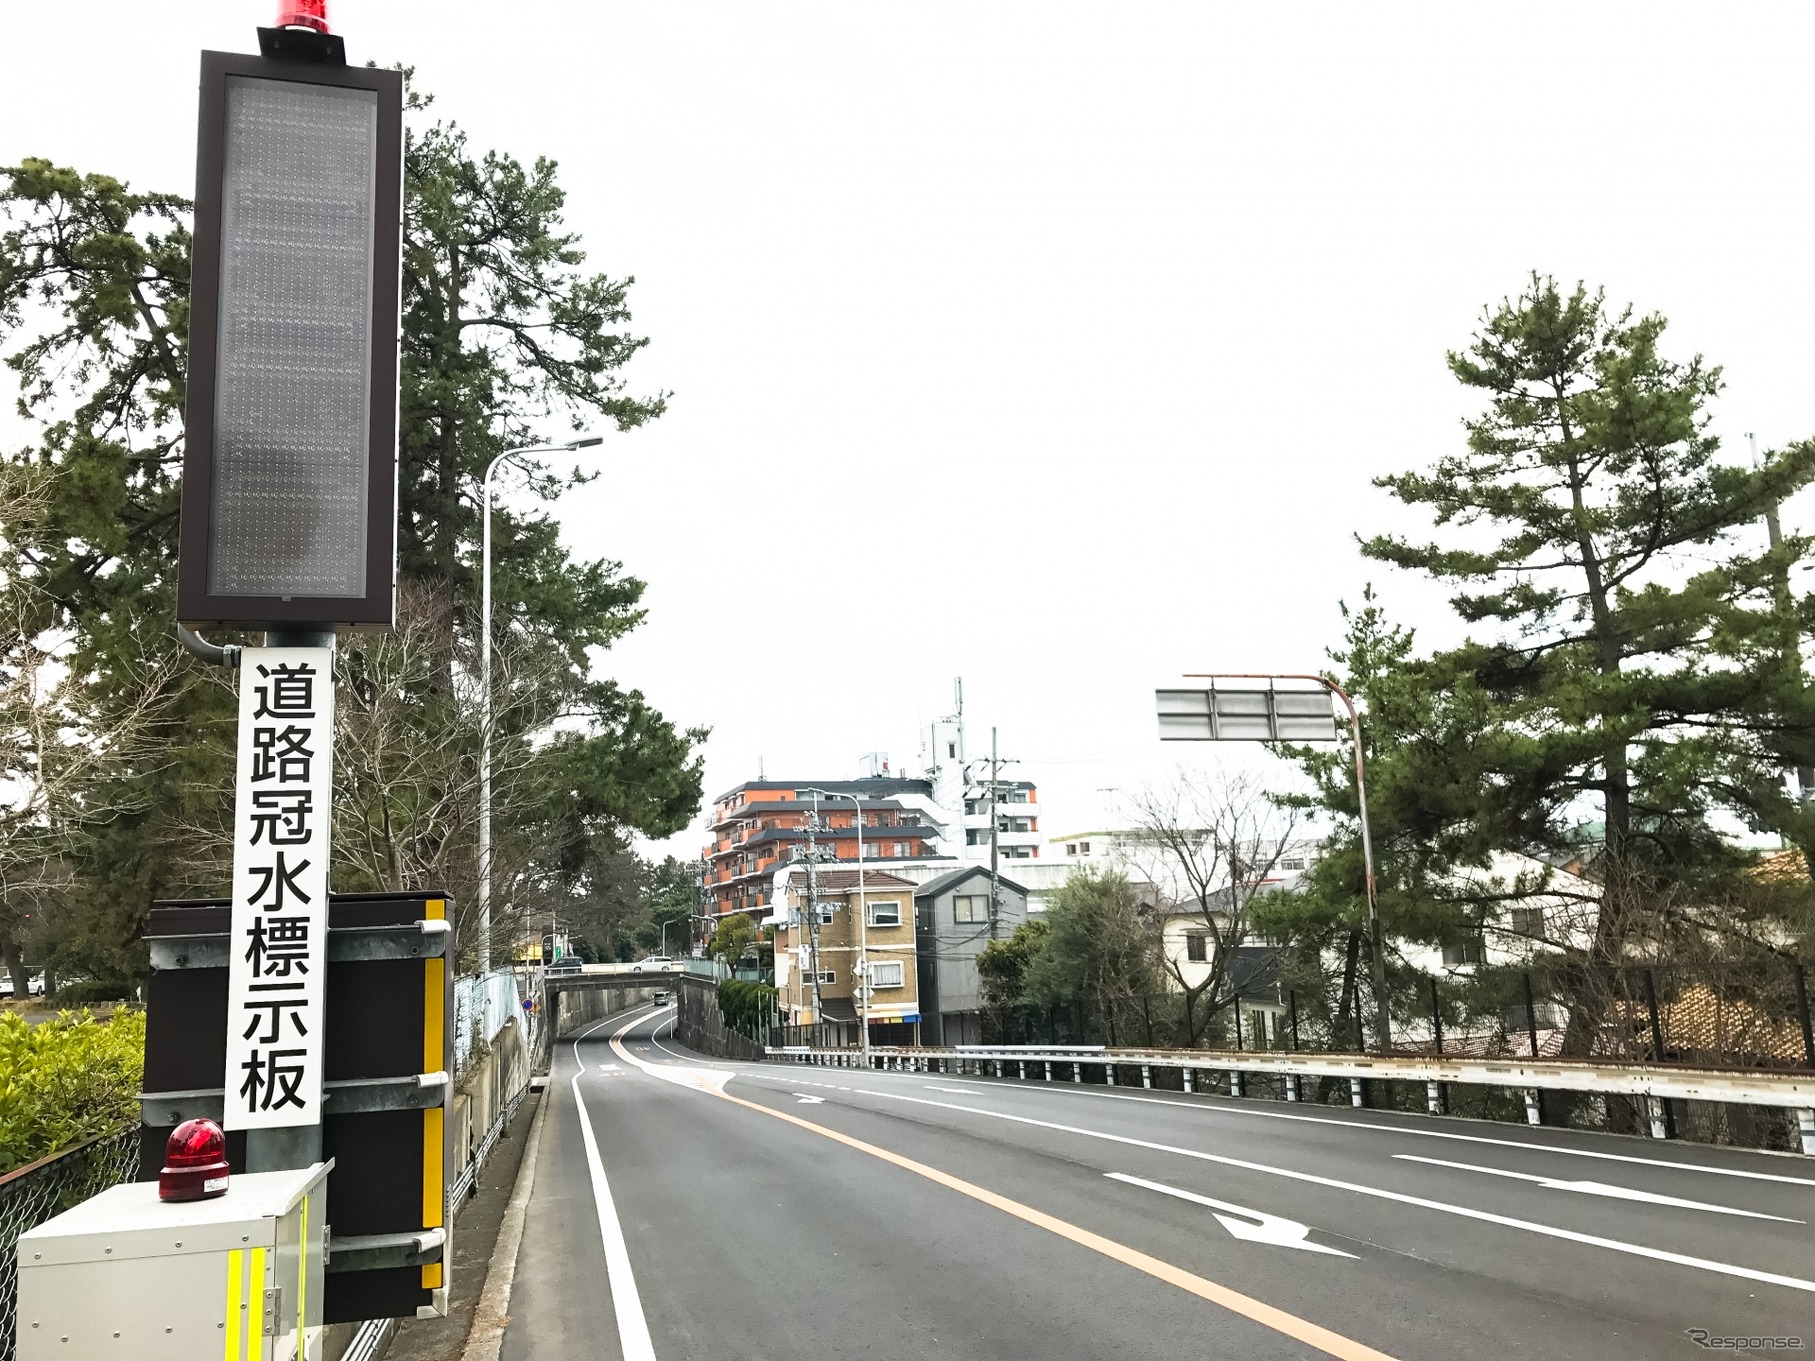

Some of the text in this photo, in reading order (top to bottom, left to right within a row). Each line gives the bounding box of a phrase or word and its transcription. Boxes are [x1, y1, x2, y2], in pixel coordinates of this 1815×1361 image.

[240, 662, 317, 1113] 道路冠水標示板
